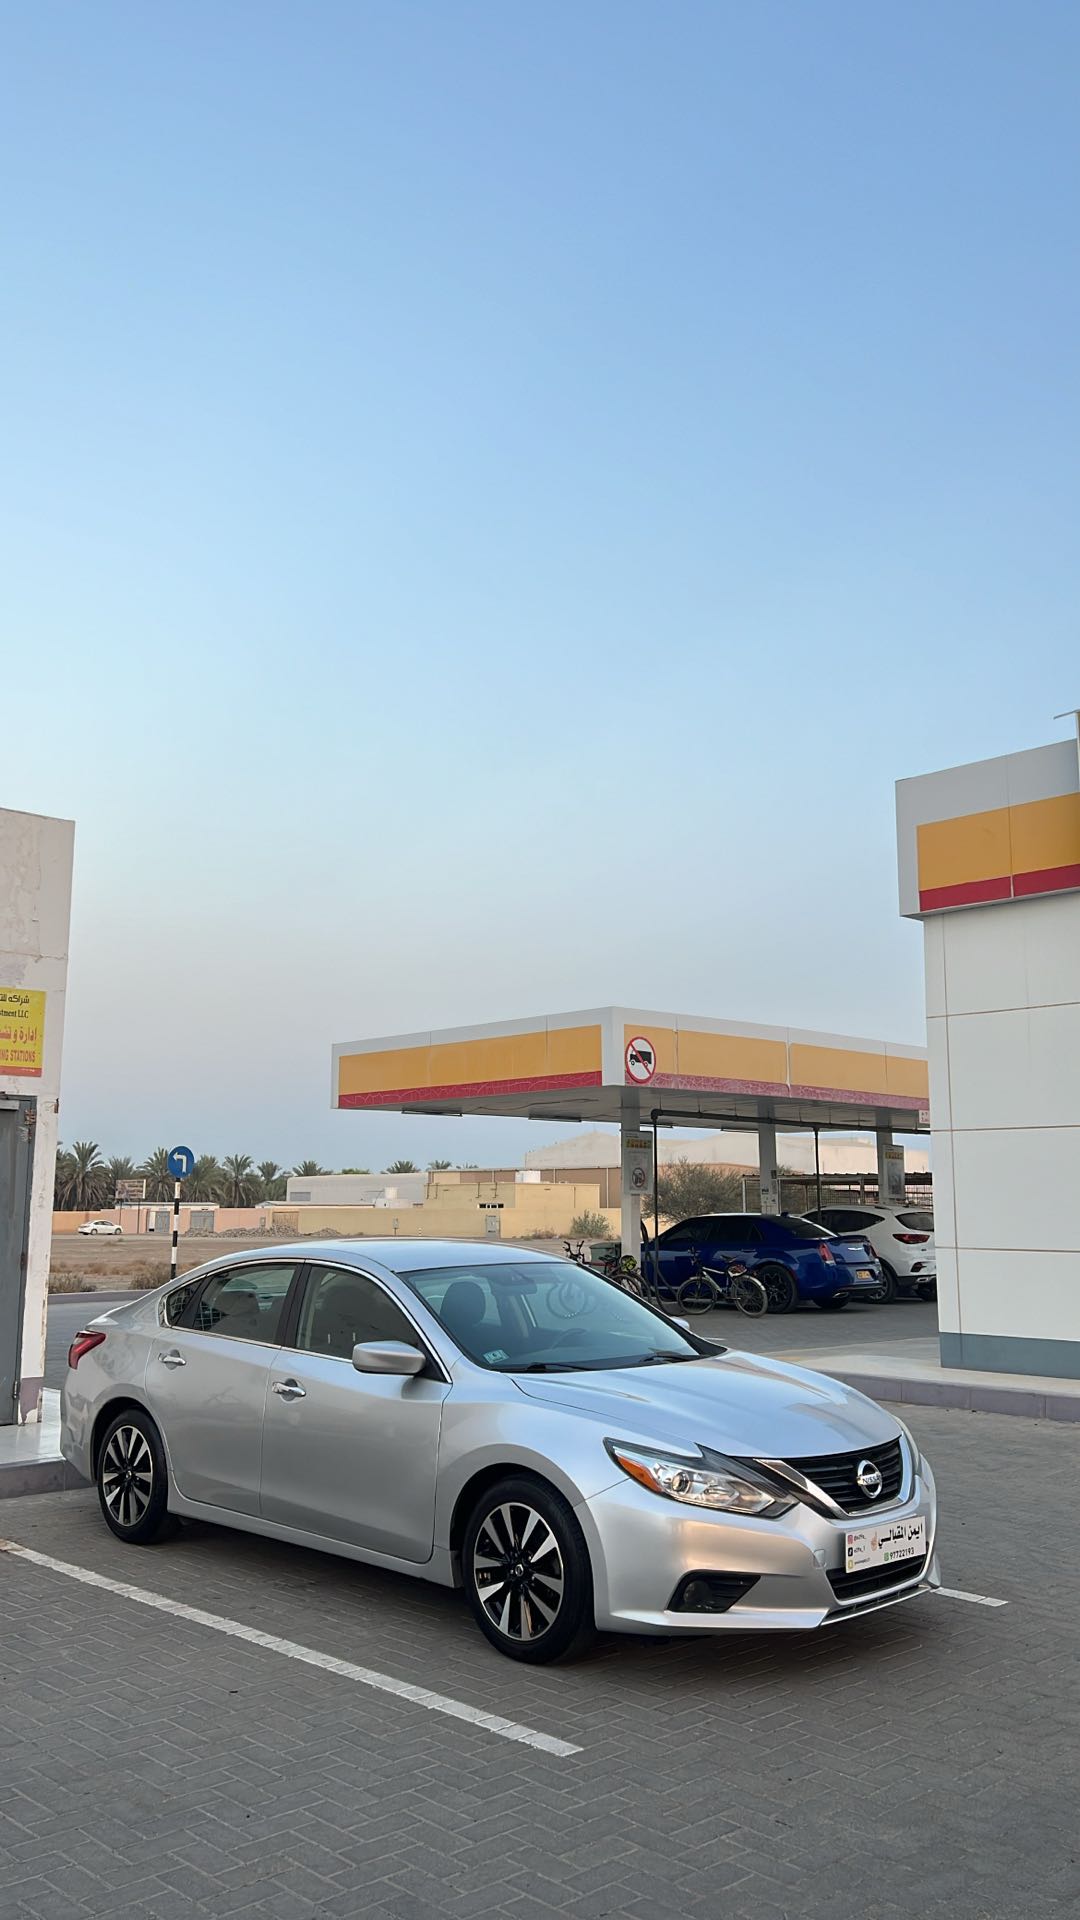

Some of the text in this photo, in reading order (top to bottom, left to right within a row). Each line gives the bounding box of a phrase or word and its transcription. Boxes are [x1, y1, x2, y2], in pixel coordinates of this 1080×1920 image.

[18, 1009, 29, 1018] LLC
[10, 1049, 36, 1063] STATIONS
[890, 1547, 915, 1560] 97722193
